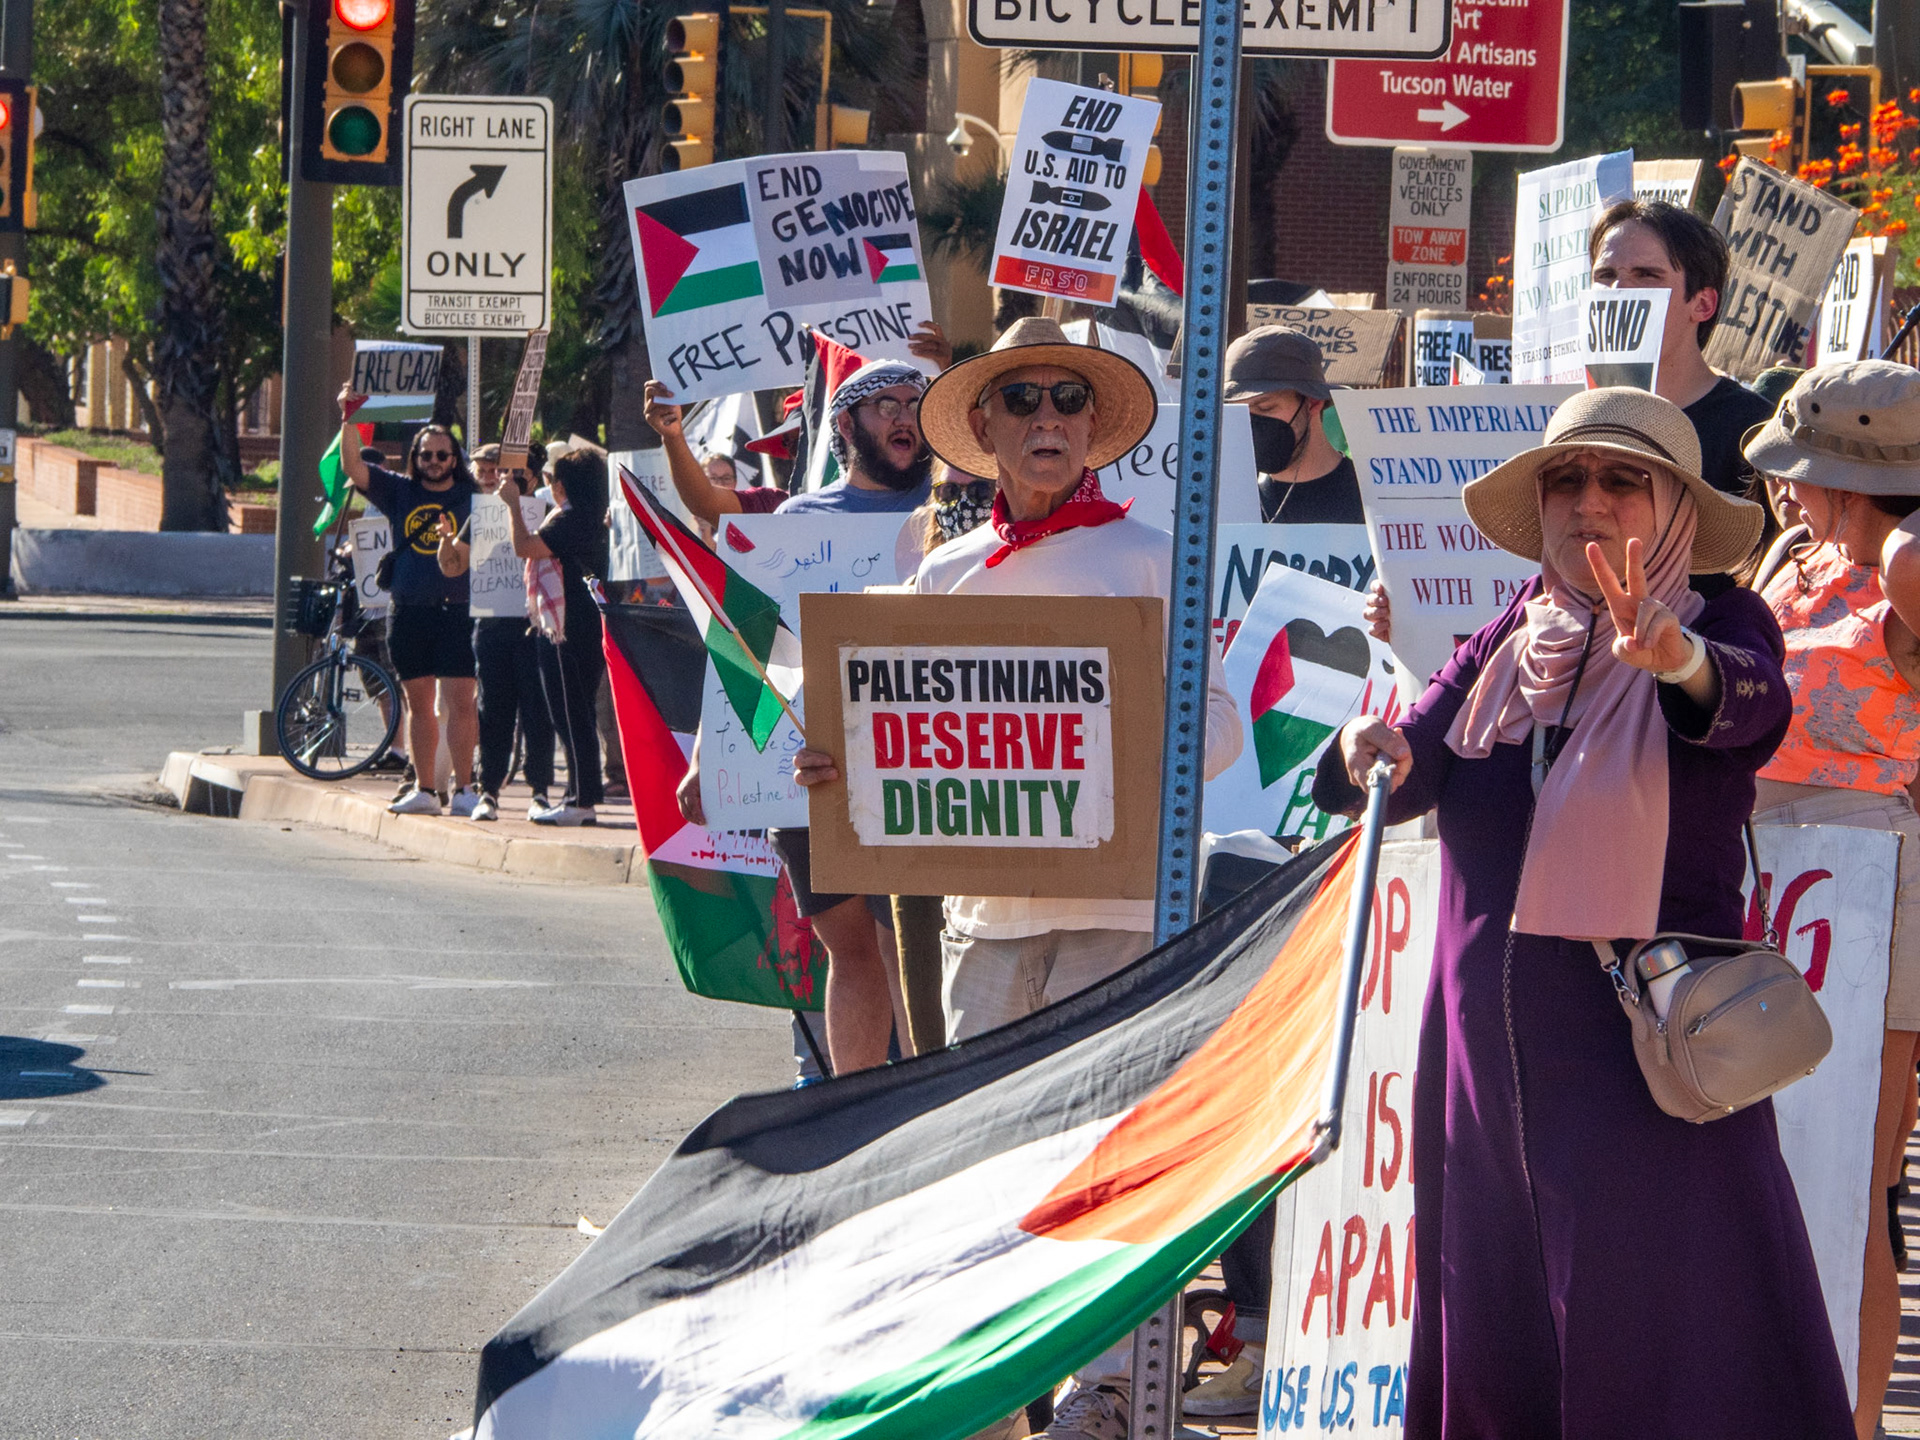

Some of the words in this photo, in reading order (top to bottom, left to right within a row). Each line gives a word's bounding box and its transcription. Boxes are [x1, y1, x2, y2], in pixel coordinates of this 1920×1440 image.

[1453, 7, 1480, 30] Art
[1456, 41, 1537, 67] Artisans
[1380, 70, 1446, 95] Tucson
[1452, 74, 1513, 99] Water
[421, 115, 475, 137] RIGHT
[486, 117, 536, 139] LANE
[1060, 95, 1123, 133] END
[1024, 149, 1059, 179] U.S.
[1065, 157, 1099, 186] AID
[1104, 163, 1127, 190] TO
[1399, 156, 1466, 172] GOVERNMENT
[1408, 170, 1456, 186] PLATED
[757, 165, 822, 202] END
[1400, 185, 1463, 203] VEHICLES
[771, 179, 917, 243] GENOCIDE
[1410, 200, 1450, 217] ONLY
[1733, 166, 1822, 236] STAND
[1010, 207, 1119, 263] ISRAEL
[1397, 229, 1424, 244] TOW
[1429, 231, 1463, 247] AWAY
[1726, 213, 1798, 279] WITH
[427, 251, 527, 278] ONLY
[778, 237, 863, 287] NOW
[1411, 246, 1446, 262] ZONE
[1025, 264, 1088, 292] FRSO
[1393, 271, 1462, 288] ENFORCED
[428, 295, 472, 309] TRANSIT
[479, 296, 522, 310] EXEMPT
[1393, 288, 1410, 303] 24
[1417, 289, 1462, 305] HOURS
[424, 312, 477, 326] BICYCLES
[483, 314, 526, 327] EXEMPT
[1254, 307, 1332, 323] STOP
[1588, 300, 1652, 353] STAND
[668, 323, 761, 390] FREE
[1417, 331, 1452, 362] FREE
[353, 351, 396, 394] FREE
[396, 351, 441, 393] GAZA
[1369, 406, 1421, 434] THE
[1370, 457, 1442, 485] STAND
[471, 505, 508, 525] STOP
[1380, 523, 1427, 551] THE
[1437, 523, 1500, 552] WOR
[1411, 578, 1474, 606] WITH
[848, 659, 1105, 704] PALESTINIANS
[872, 711, 1085, 770] DESERVE
[883, 778, 1081, 837] DIGNITY
[1363, 1071, 1417, 1192] IS
[1262, 1363, 1311, 1433] USE
[1319, 1360, 1358, 1434] U.S.
[1368, 1363, 1408, 1428] TA
